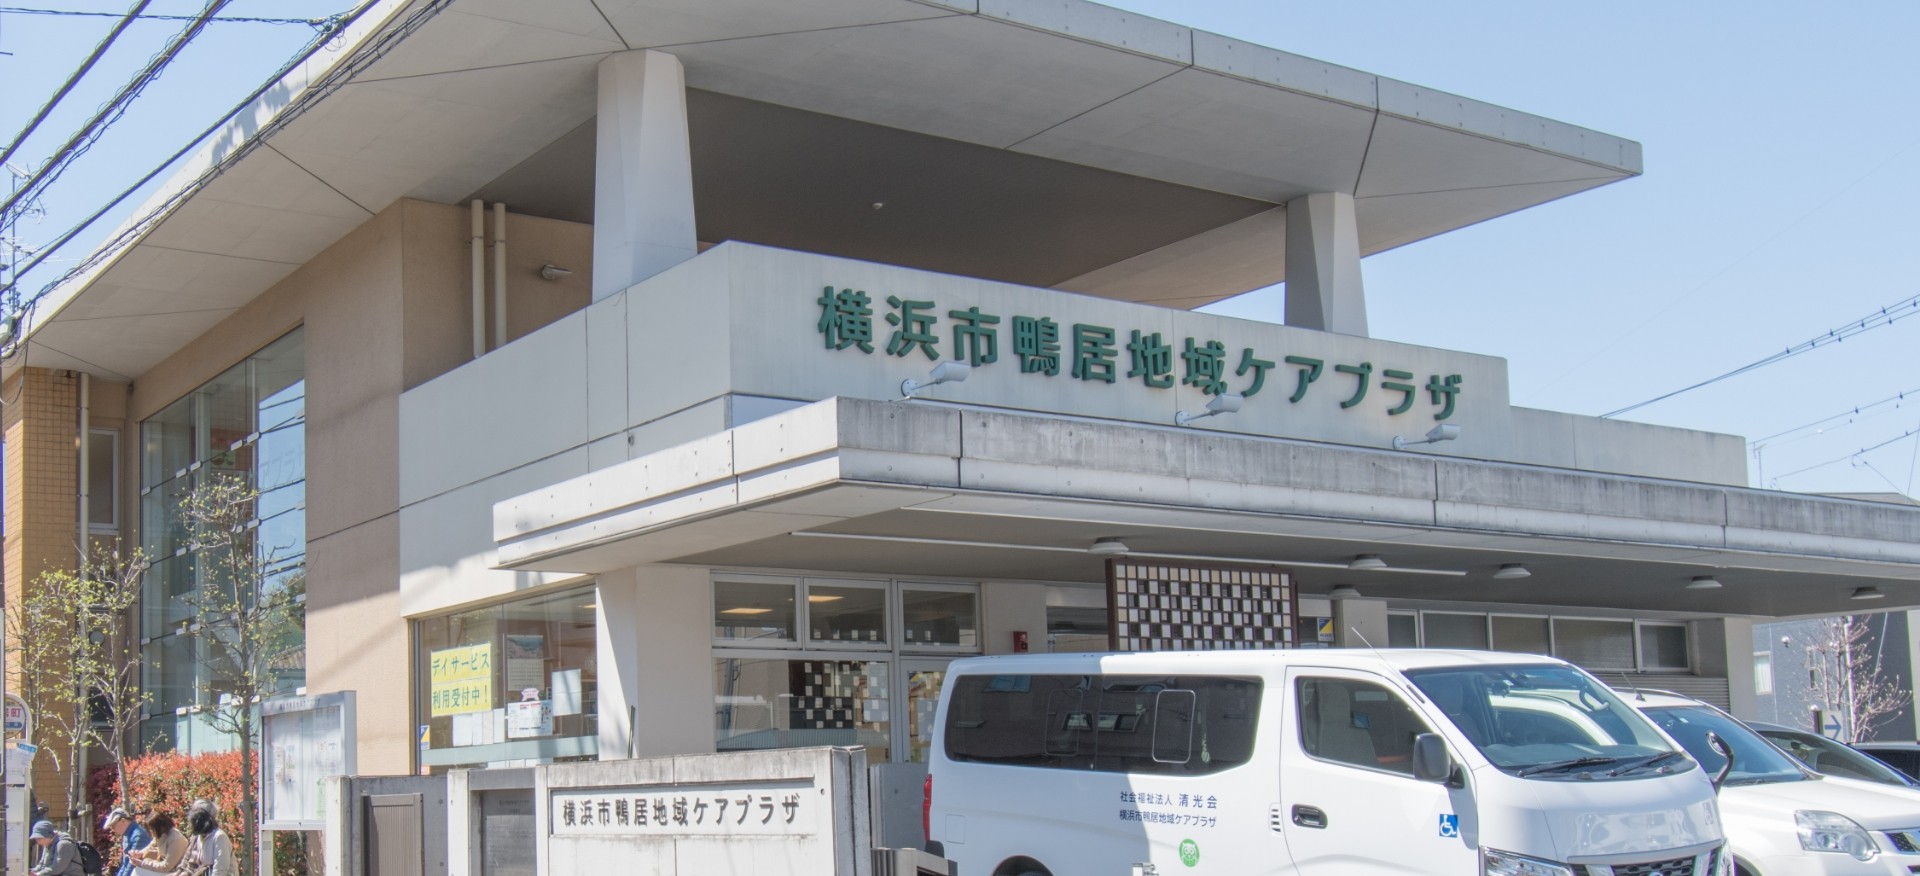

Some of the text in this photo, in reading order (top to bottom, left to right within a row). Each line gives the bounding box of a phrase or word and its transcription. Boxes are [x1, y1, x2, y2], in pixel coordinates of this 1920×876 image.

[817, 285, 1462, 420] 横浜市鴨居地域ケアプラザ
[432, 653, 489, 677] デイサービス
[563, 792, 800, 827] 横浜市鴨居地域ケアプラザ
[1120, 791, 1217, 808] 社会福祉法人 清光会
[1119, 809, 1217, 827] 横浜市鴨居地域ケアプラザ
